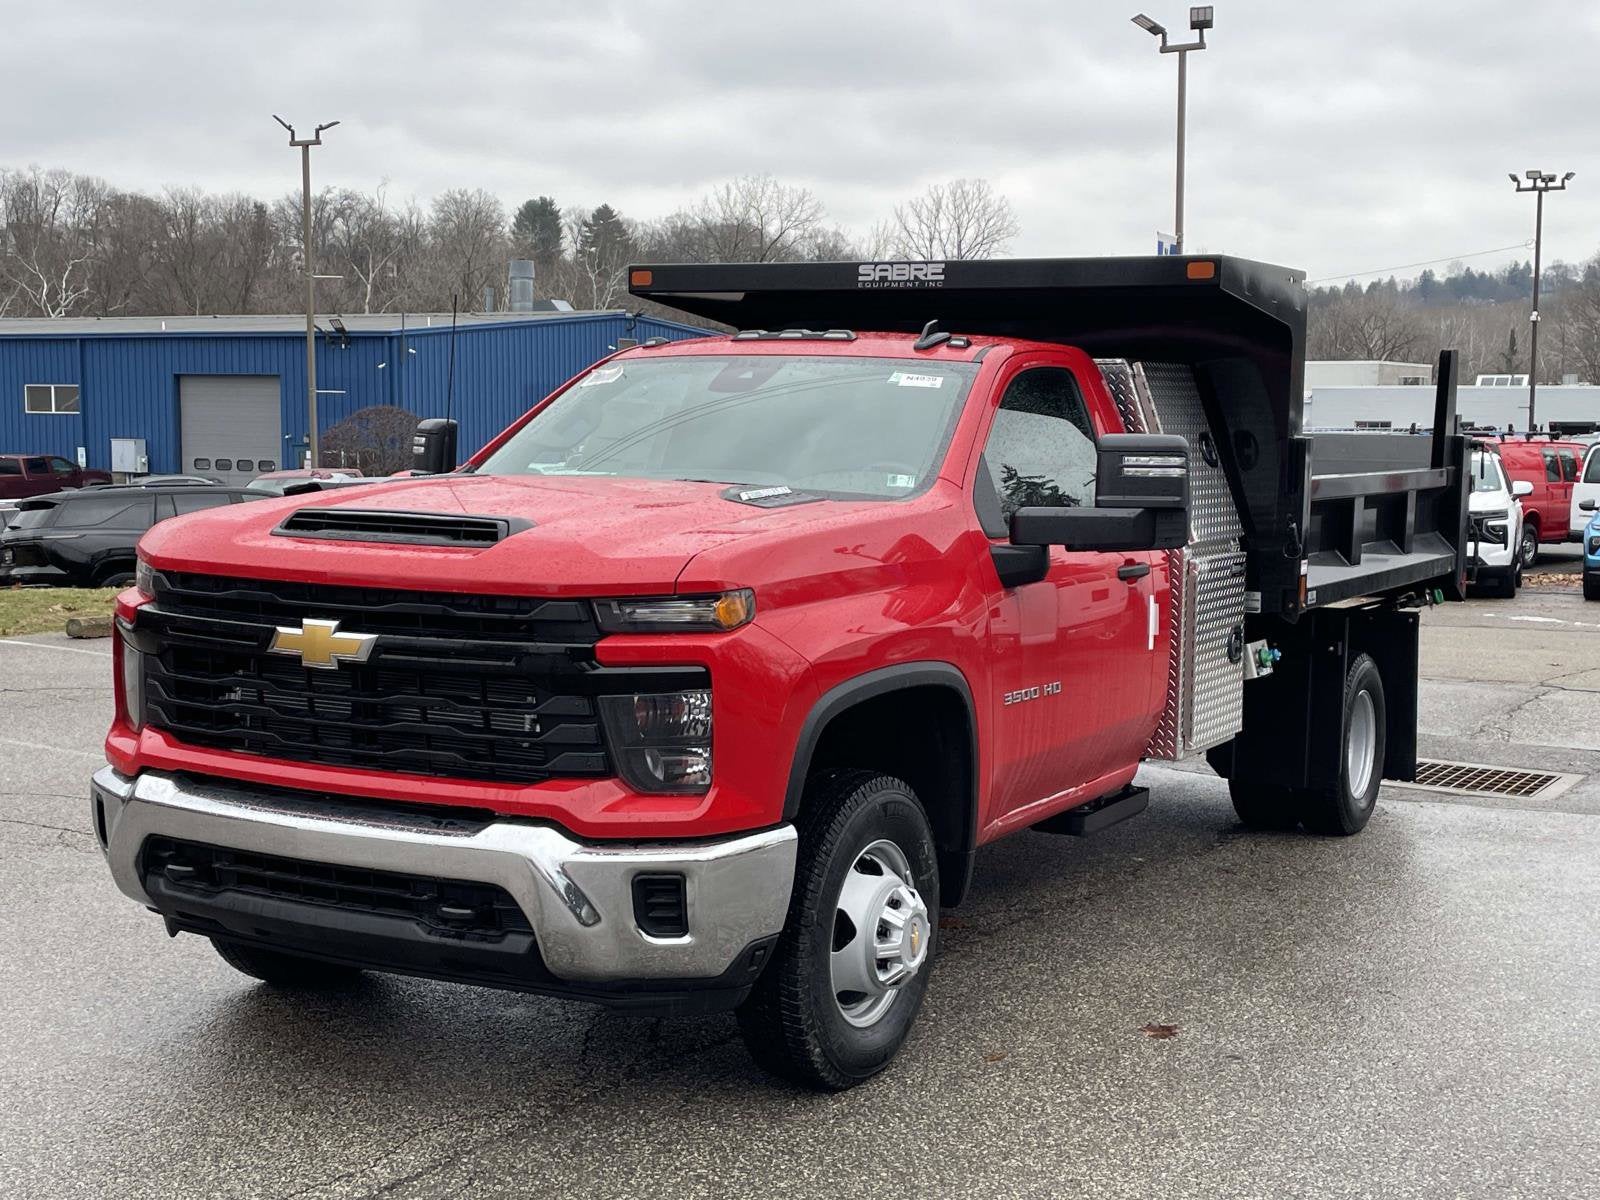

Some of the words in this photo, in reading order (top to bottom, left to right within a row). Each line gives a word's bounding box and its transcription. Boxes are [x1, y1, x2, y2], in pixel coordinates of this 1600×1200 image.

[858, 263, 945, 281] SABRE
[1004, 686, 1040, 705] 3500
[1043, 681, 1061, 696] HD
